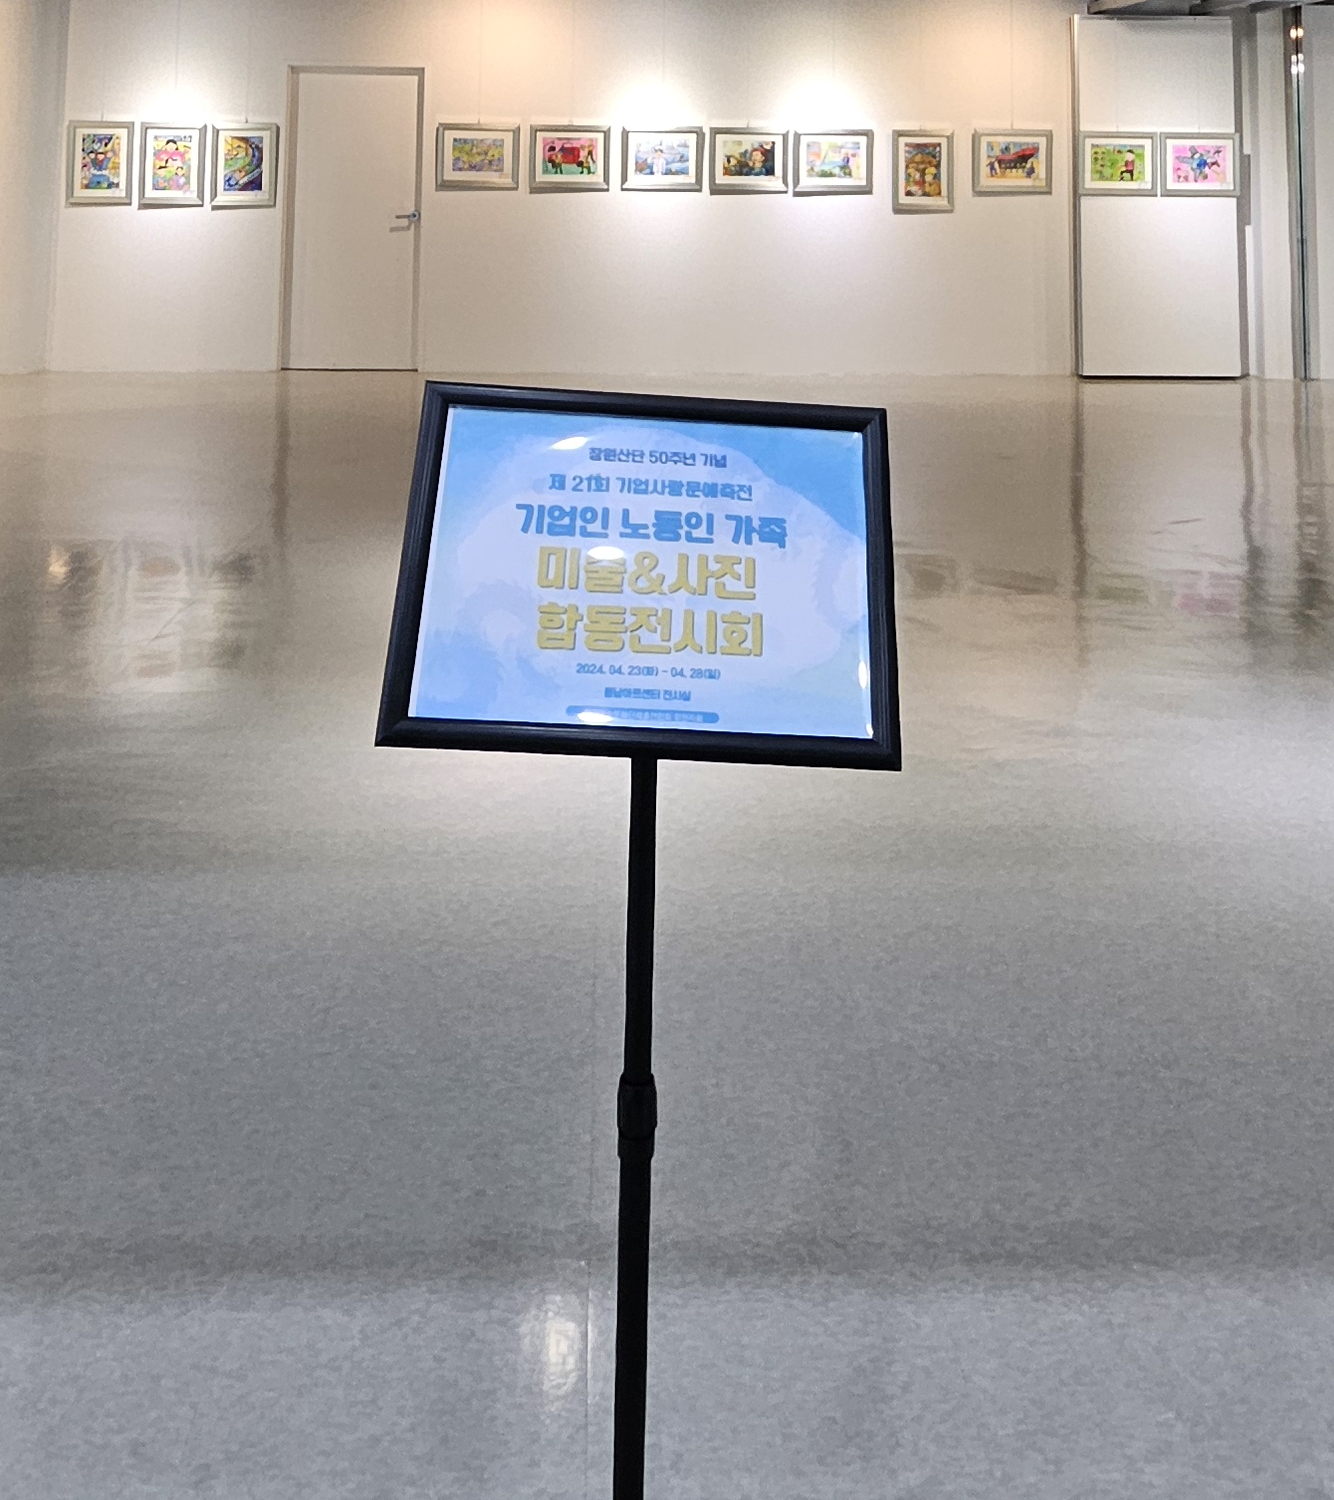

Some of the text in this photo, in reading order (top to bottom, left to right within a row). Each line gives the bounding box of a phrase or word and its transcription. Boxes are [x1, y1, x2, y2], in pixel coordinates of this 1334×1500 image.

[649, 450, 696, 467] 50주년
[702, 453, 728, 469] 기념
[548, 473, 566, 491] 제
[572, 474, 610, 493] 21회
[515, 503, 788, 549] 기업인 노동인 가족
[536, 545, 757, 601] 미술&사진
[535, 601, 765, 658] 합동전시회
